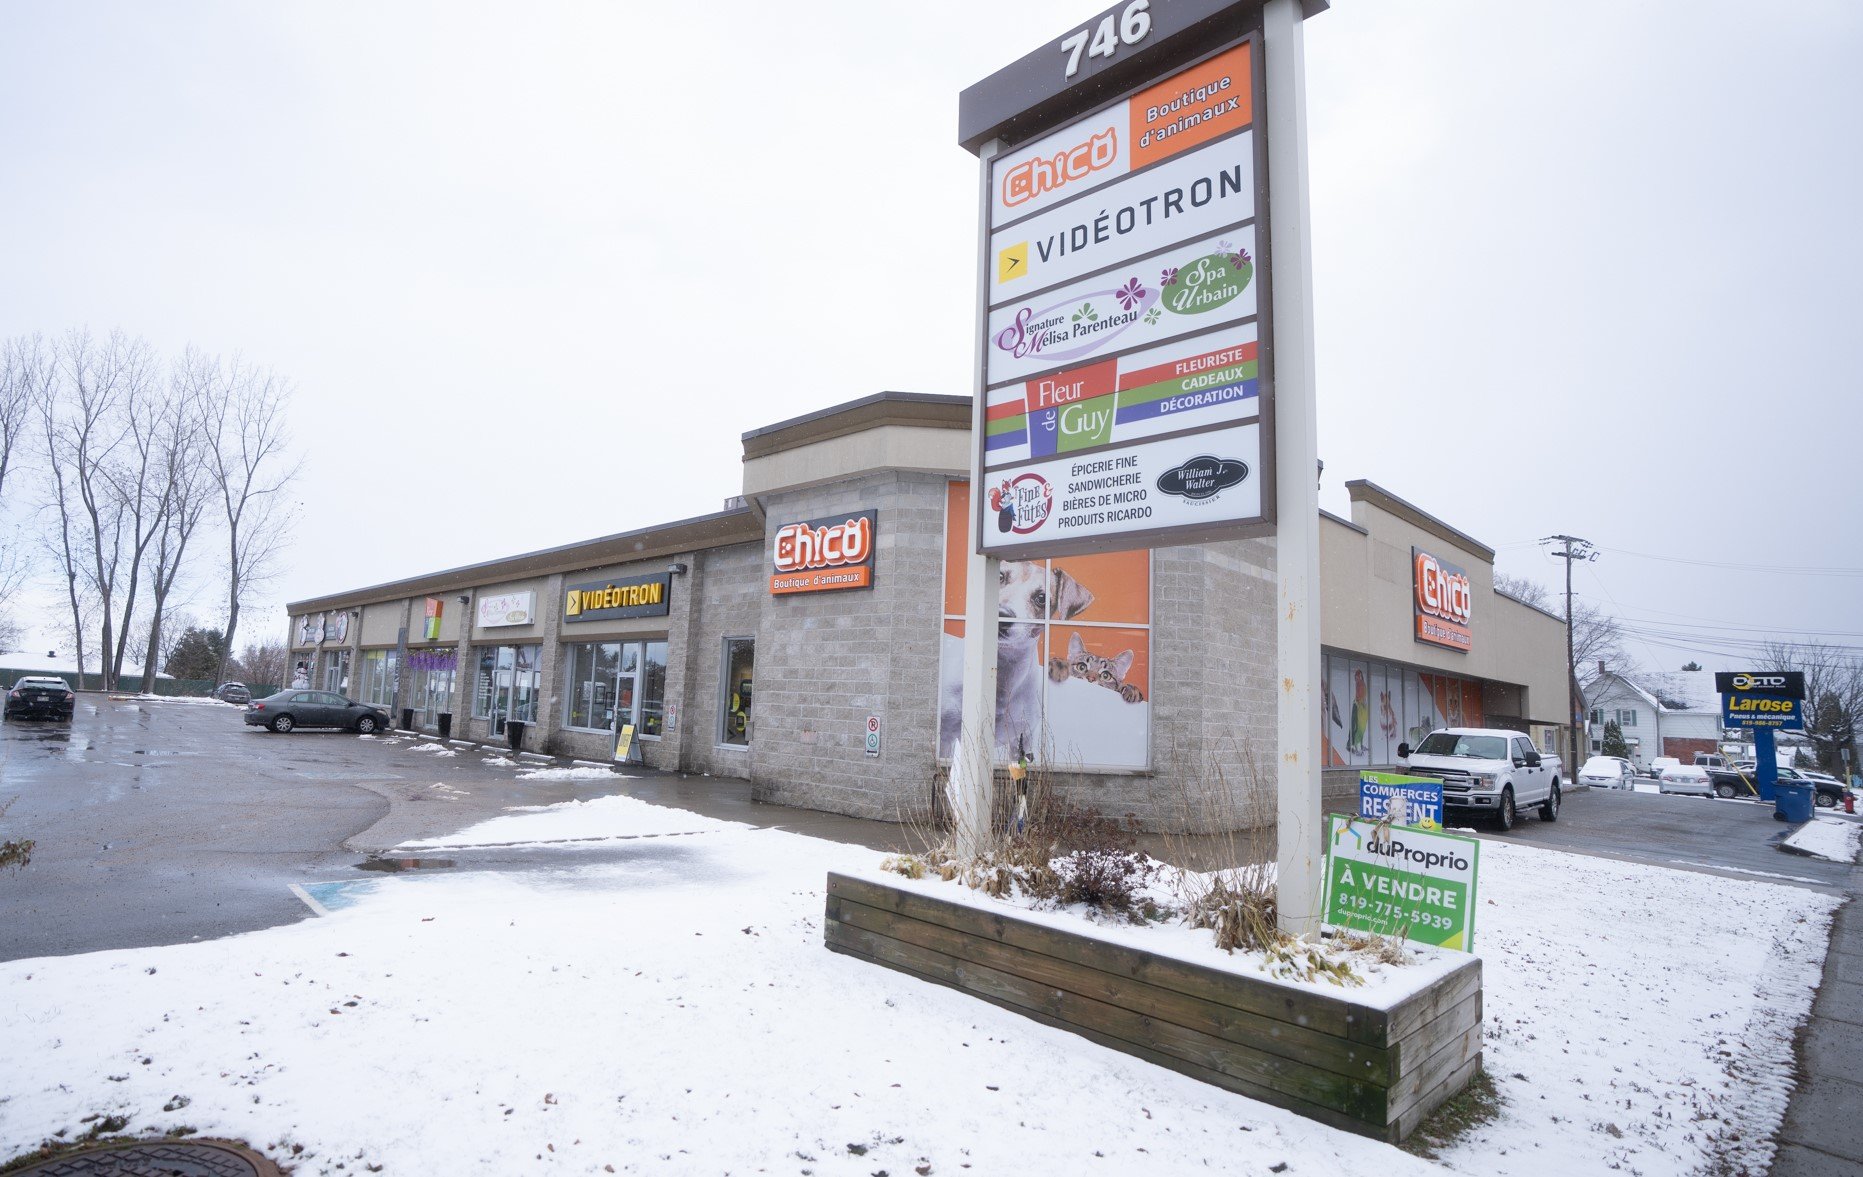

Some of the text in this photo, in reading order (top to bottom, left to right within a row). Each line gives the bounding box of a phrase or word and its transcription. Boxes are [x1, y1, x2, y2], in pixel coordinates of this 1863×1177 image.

[1061, 0, 1151, 81] 746
[1146, 76, 1231, 122] Boutique
[1139, 95, 1241, 148] d'animaux
[1002, 127, 1118, 208] Chico
[1036, 165, 1242, 263] VIDÉOTRON
[1185, 258, 1226, 286] Spa
[1172, 283, 1238, 311] Urbain
[998, 308, 1065, 351] Signature
[1014, 310, 1138, 359] Mélisa Parenteau
[1175, 348, 1243, 375] FLEURISTE
[1040, 379, 1084, 407] Fleur
[1181, 367, 1243, 392] CADEAUX
[1160, 385, 1243, 414] DÉCORATION
[1042, 410, 1057, 432] de
[1060, 404, 1110, 440] Guy
[1071, 455, 1138, 477] ÉPICERIE FINE
[1177, 466, 1213, 480] William
[1068, 472, 1142, 494] SANDWICHERIE
[1186, 478, 1216, 490] Walter
[1063, 489, 1147, 511] BIÈRES DE MICRO
[1058, 506, 1153, 528] PRODUITS RICARDO
[774, 516, 870, 572] Chico
[774, 573, 860, 589] Boutique d'animaux
[582, 582, 663, 611] VIDÉOTRON
[1729, 696, 1793, 712] Larose
[1729, 712, 1750, 720] Pneus
[1757, 713, 1796, 721] mécanique
[1363, 775, 1378, 783] LES
[1363, 784, 1438, 802] COMMERCES
[1367, 840, 1468, 871] duProprio
[1340, 863, 1457, 909] À VENDRE
[1338, 892, 1453, 930] 819-775-5939
